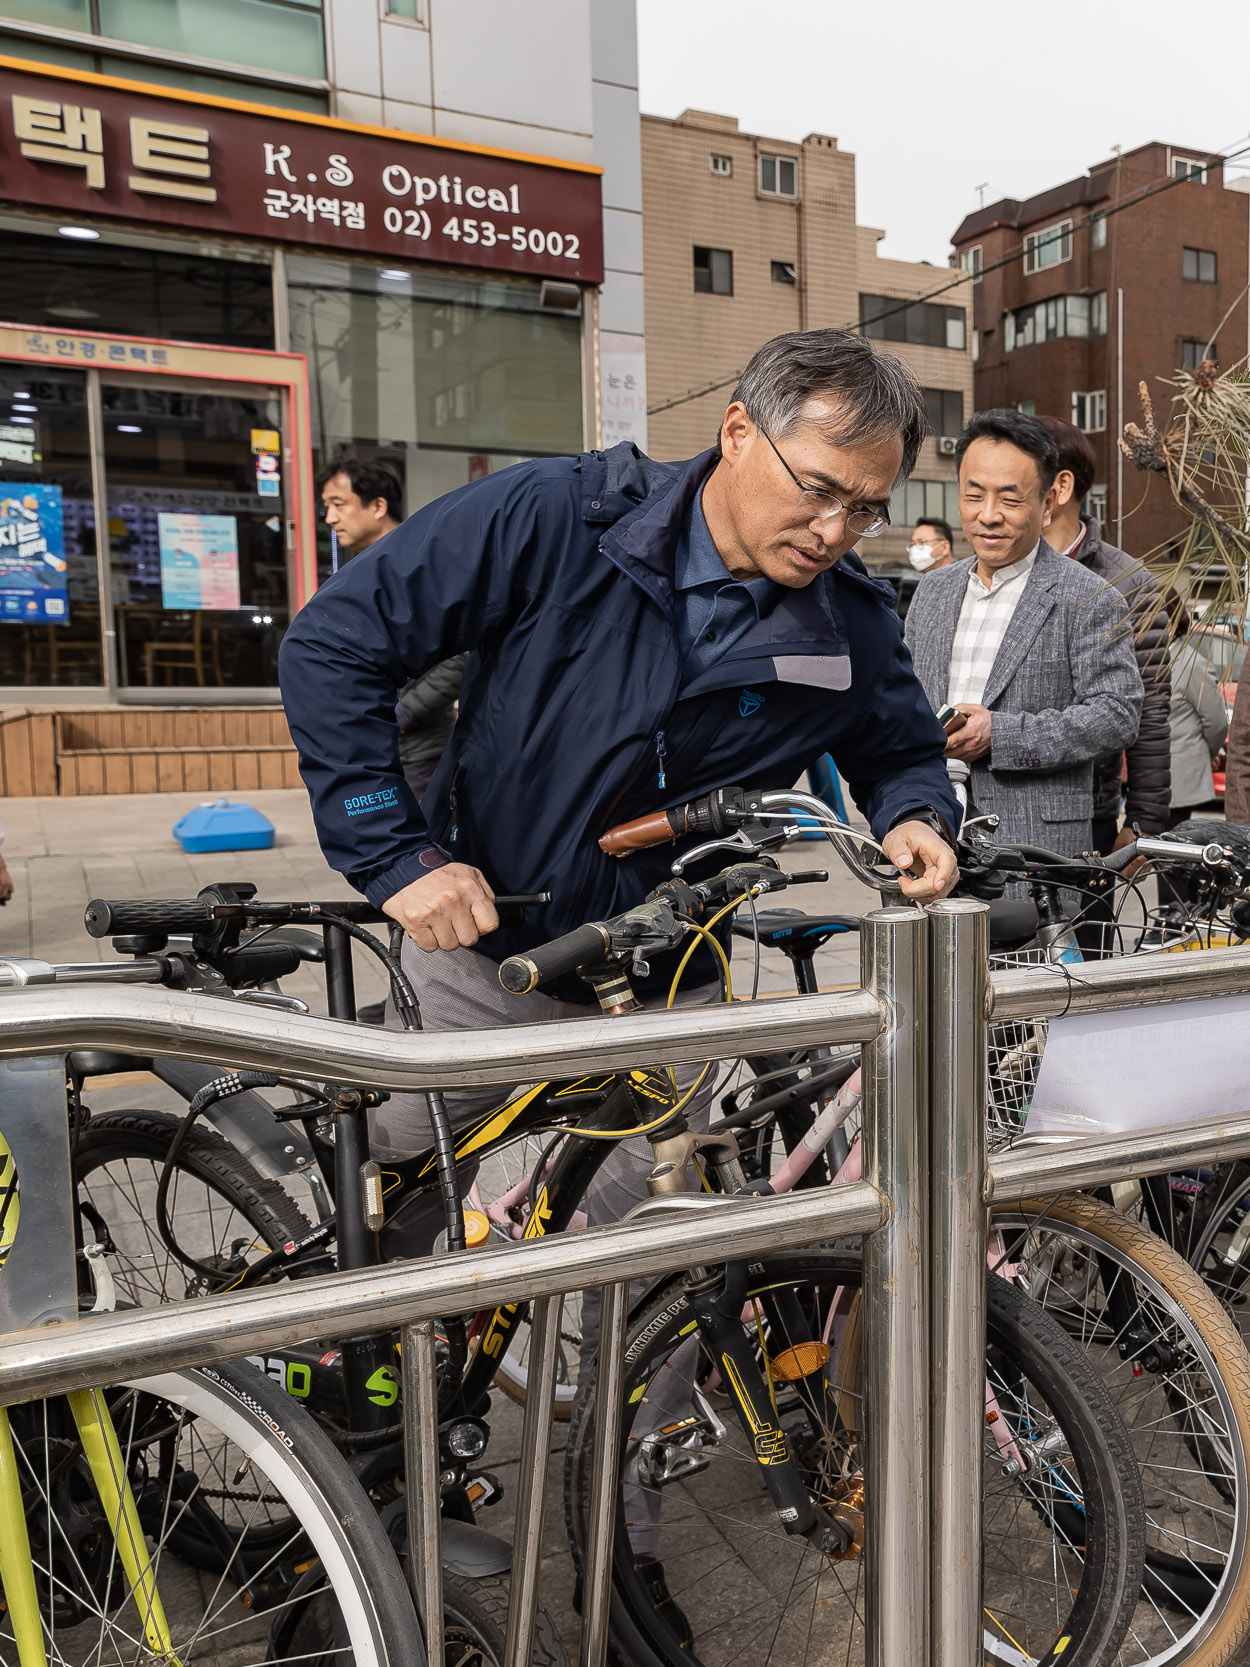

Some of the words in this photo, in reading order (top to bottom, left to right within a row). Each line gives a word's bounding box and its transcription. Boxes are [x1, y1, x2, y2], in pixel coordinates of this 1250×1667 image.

[382, 164, 520, 214] Optical
[263, 188, 366, 230] 군자역점
[383, 206, 432, 240] 02)
[442, 216, 580, 259] 453-5002
[628, 1080, 669, 1104] LESPO
[625, 1312, 672, 1363] DYNAMIC
[263, 1414, 294, 1447] ROAD
